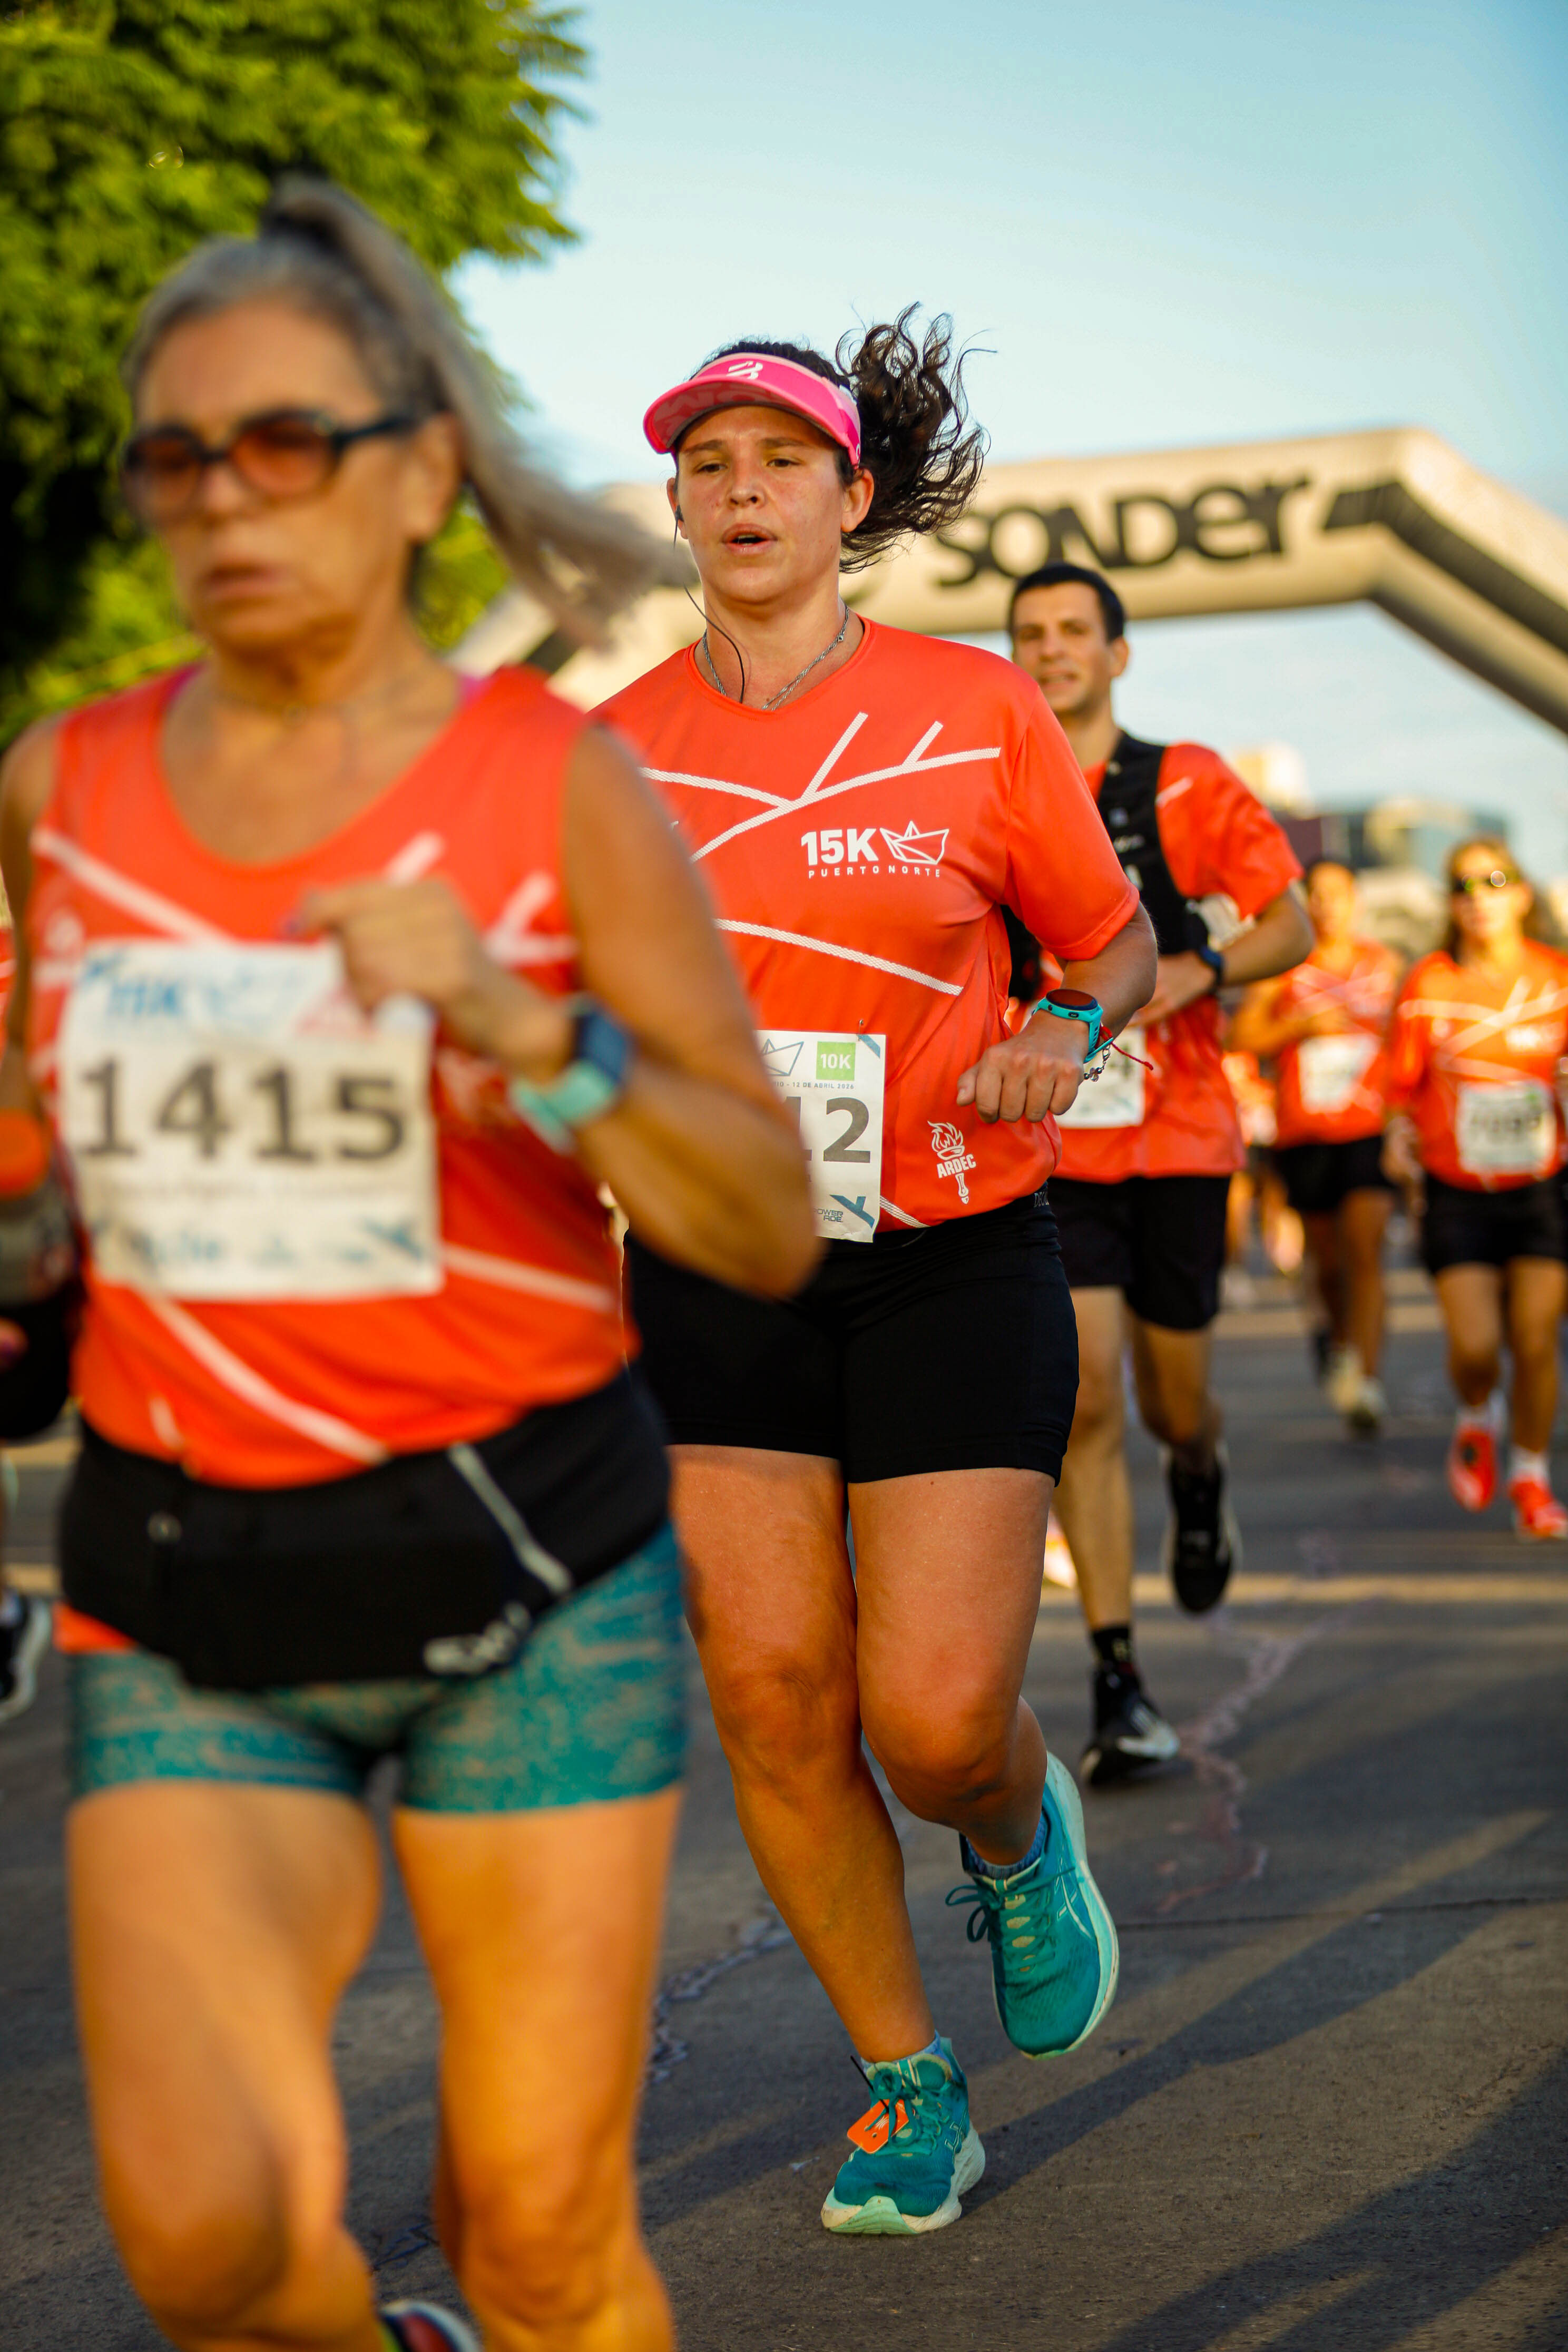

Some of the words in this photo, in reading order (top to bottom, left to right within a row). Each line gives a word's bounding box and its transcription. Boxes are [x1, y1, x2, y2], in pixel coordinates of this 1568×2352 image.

[801, 828, 879, 866] 15K
[808, 866, 879, 879] PUERTO
[888, 865, 940, 877] NORTE
[820, 1053, 852, 1070] 10K
[79, 1057, 407, 1163] 1415
[936, 1154, 976, 1179] ARDEC
